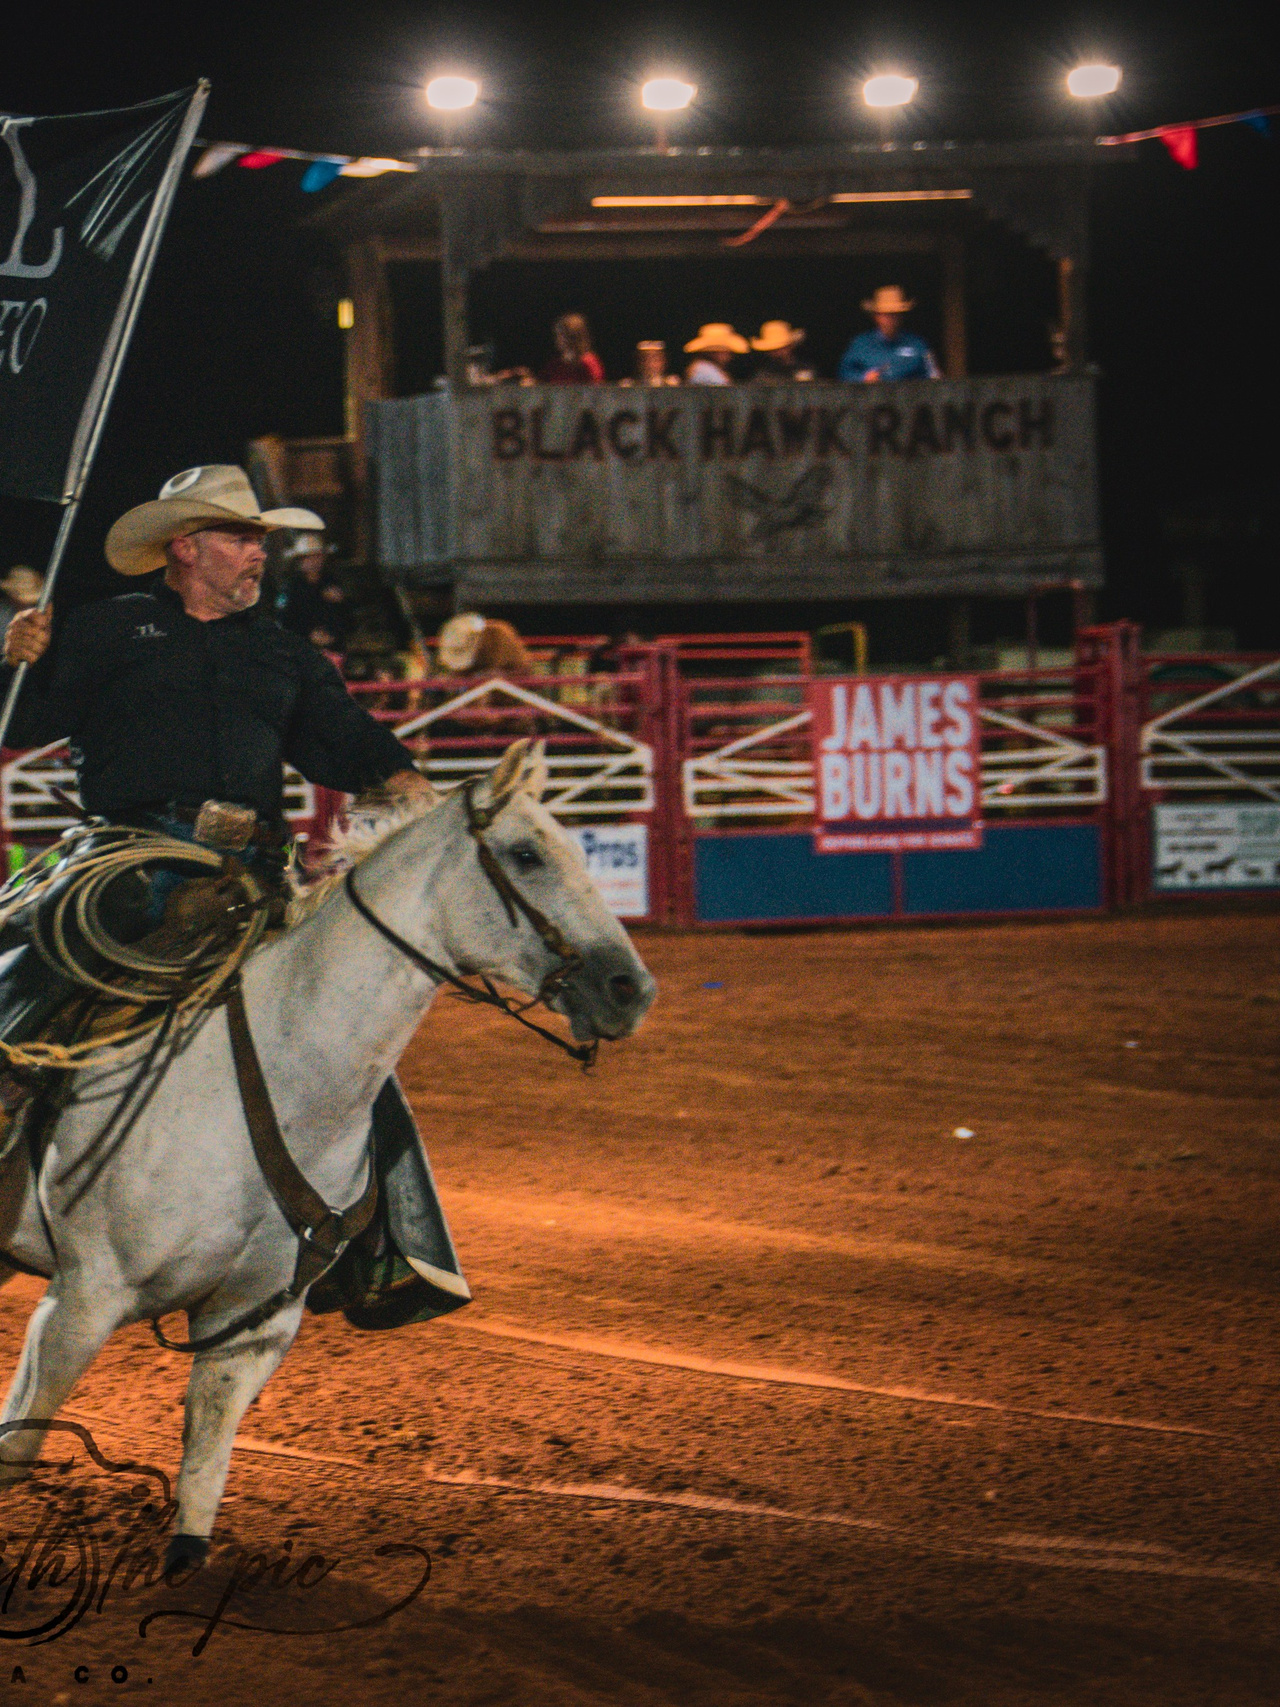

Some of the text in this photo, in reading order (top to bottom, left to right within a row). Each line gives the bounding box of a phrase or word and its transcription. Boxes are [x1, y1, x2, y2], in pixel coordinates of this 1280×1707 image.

[493, 397, 1056, 463] BLACK HAWK RANCH
[822, 681, 972, 750] JAMES
[822, 750, 974, 820] BURNS
